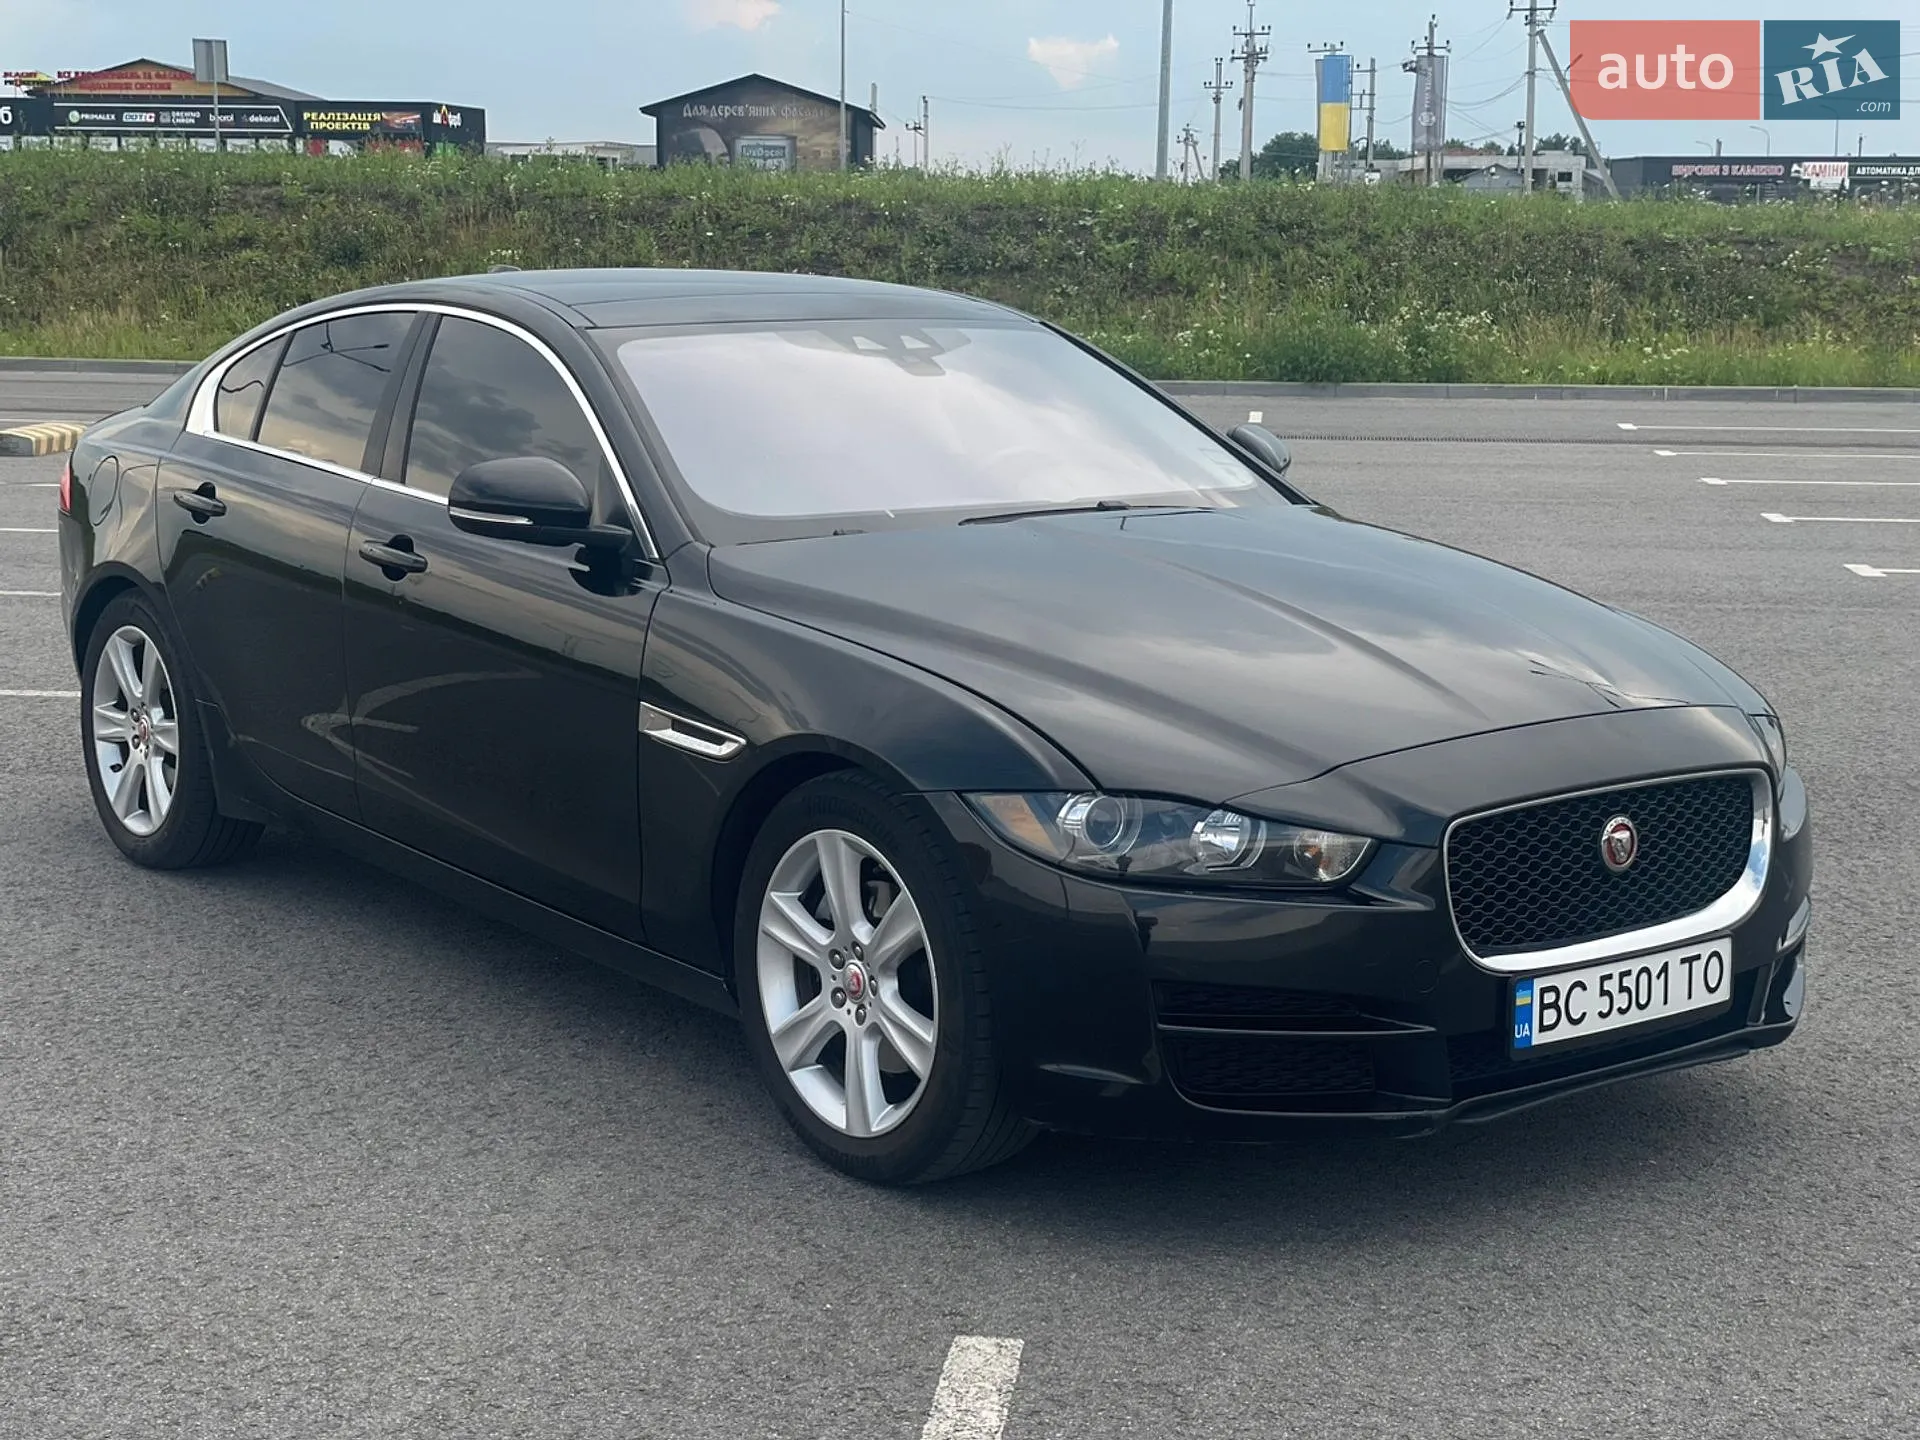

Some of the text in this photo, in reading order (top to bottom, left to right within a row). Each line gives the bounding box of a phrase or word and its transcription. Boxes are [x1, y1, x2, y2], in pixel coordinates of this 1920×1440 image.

[249, 114, 280, 123] dekoral
[303, 112, 382, 121] РЕАЛІЗАЦІЯ
[310, 121, 371, 131] ПРОЕКТІВ
[1803, 164, 1847, 177] КАМІНИ
[1856, 166, 1907, 176] АВТОМАТИКА
[1538, 950, 1724, 1033] BC 5501 TO
[1514, 1023, 1531, 1038] UA
